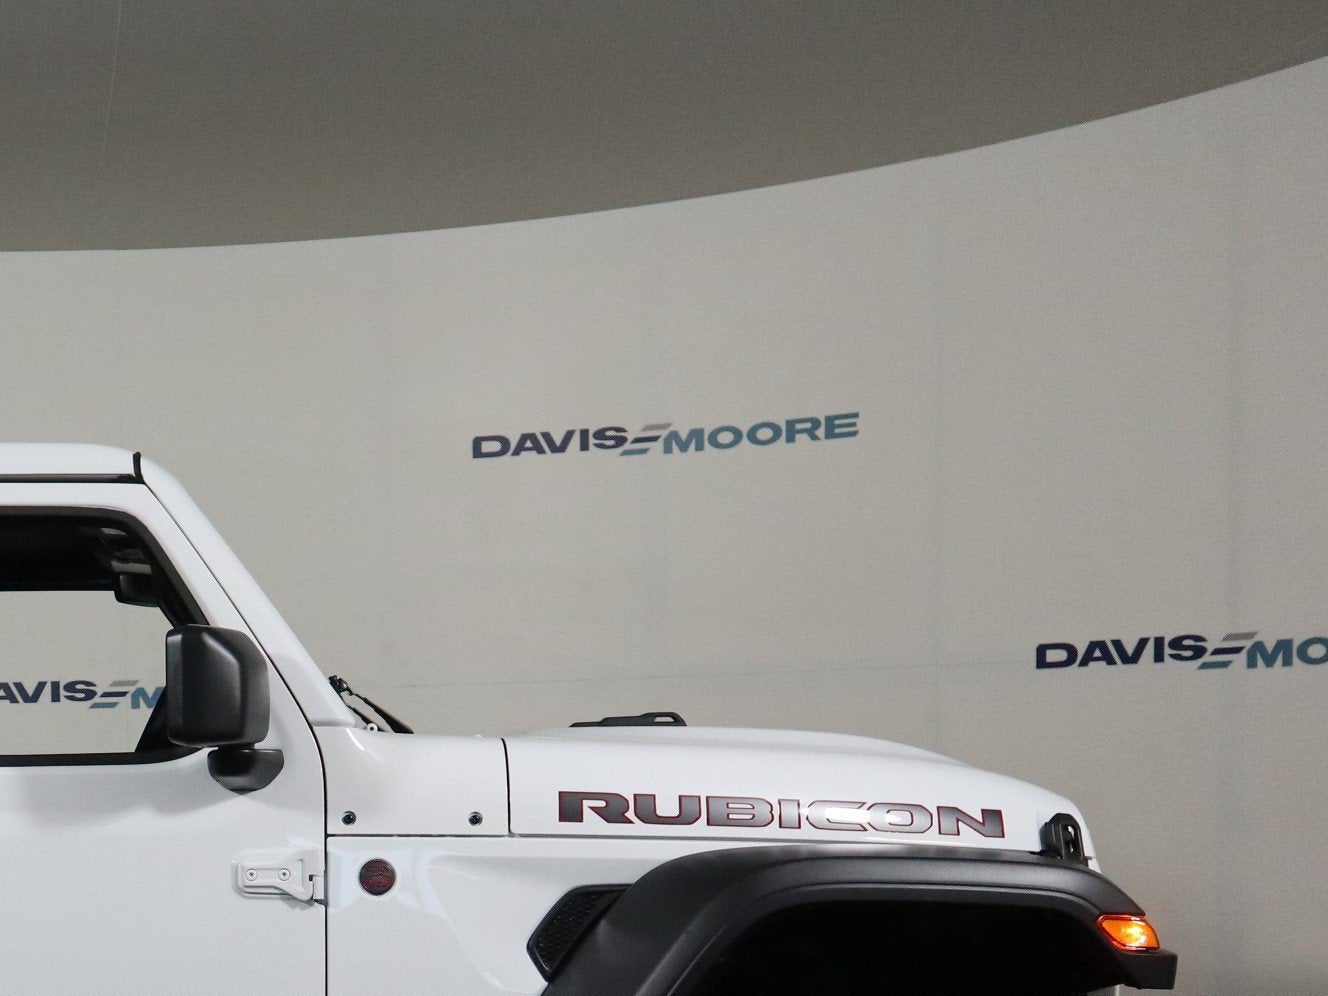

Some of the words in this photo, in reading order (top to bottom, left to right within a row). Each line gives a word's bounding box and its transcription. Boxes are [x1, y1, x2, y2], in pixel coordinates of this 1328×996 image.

[472, 426, 628, 458] DAVIS
[663, 412, 859, 454] MOORE
[1037, 635, 1208, 669] DAVIS
[558, 791, 1006, 839] RUBICON
